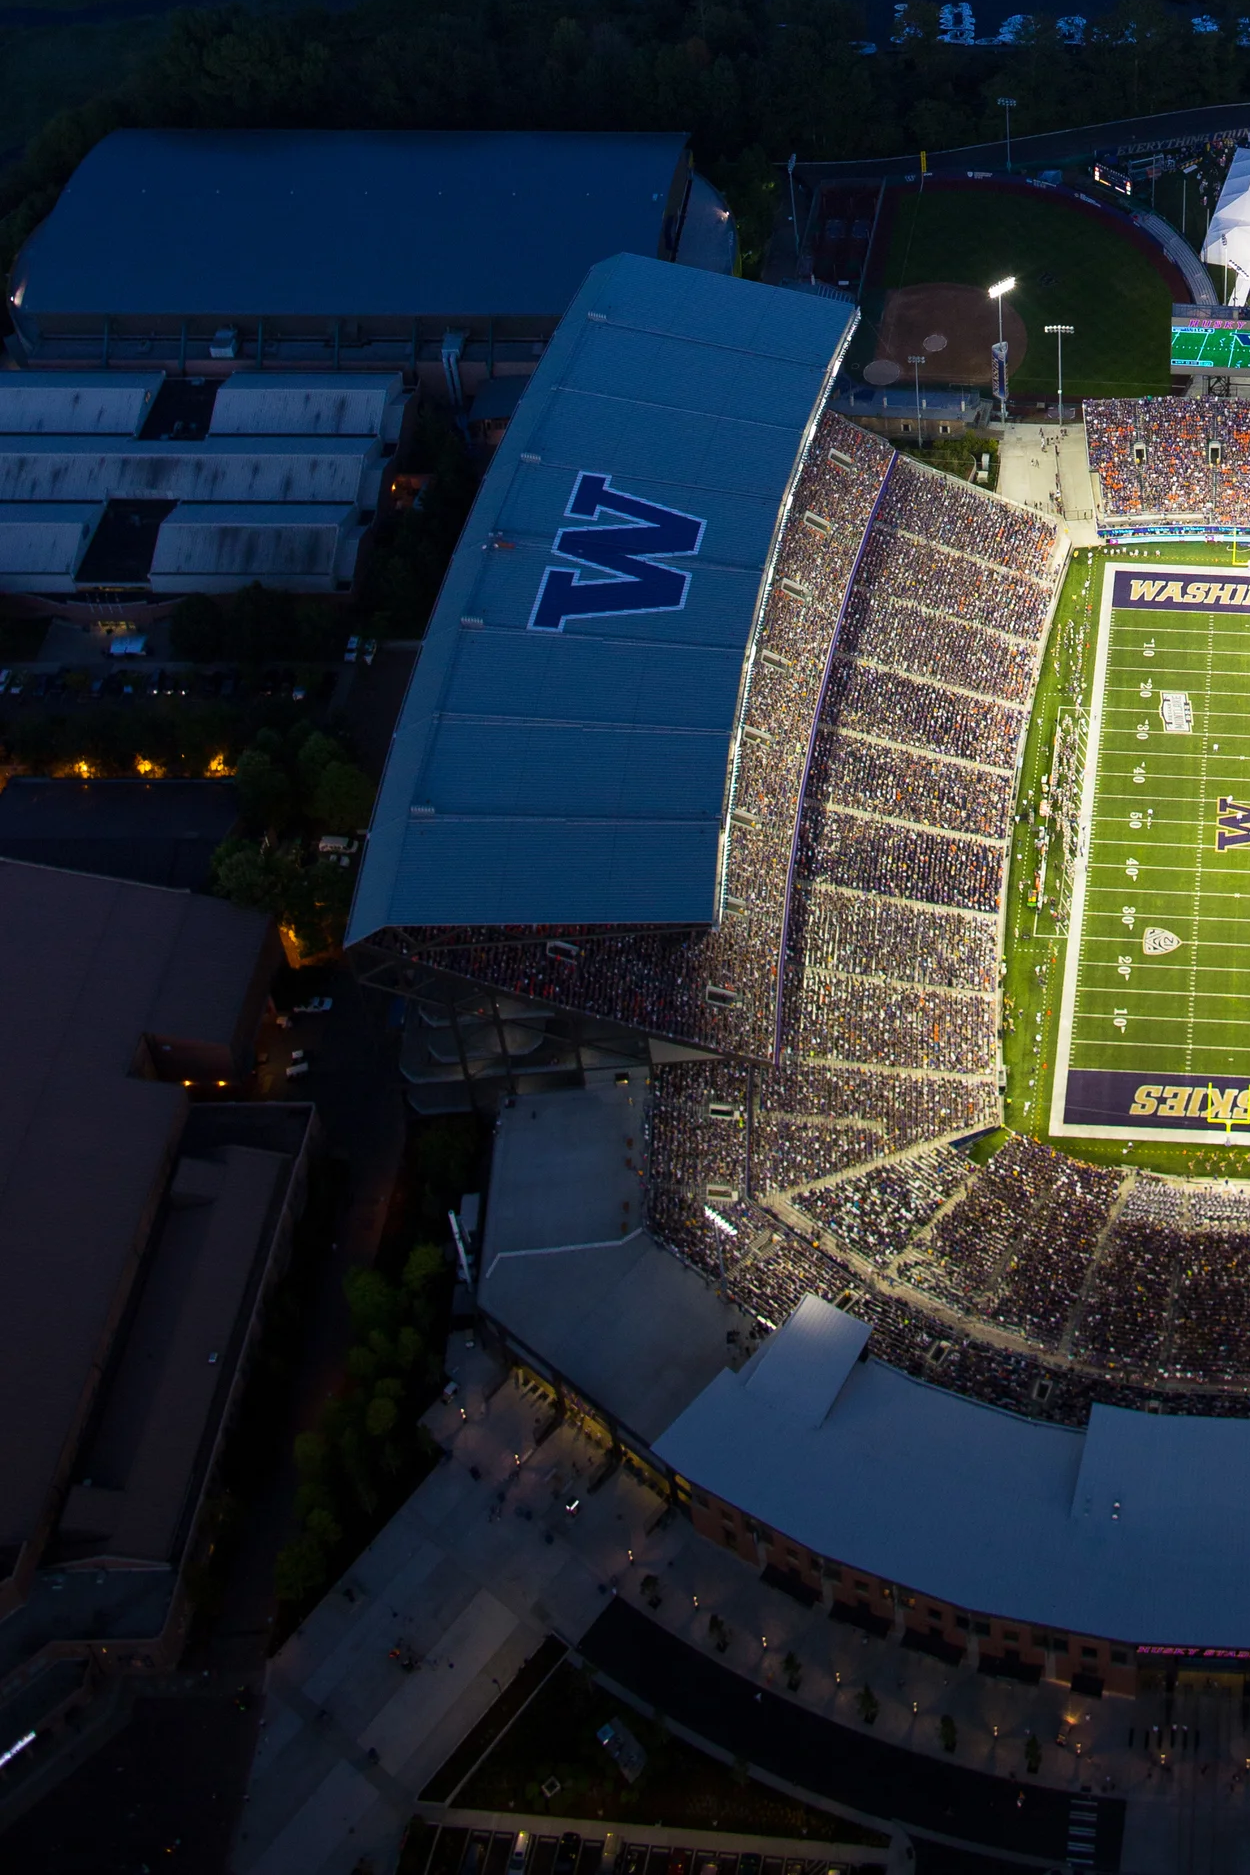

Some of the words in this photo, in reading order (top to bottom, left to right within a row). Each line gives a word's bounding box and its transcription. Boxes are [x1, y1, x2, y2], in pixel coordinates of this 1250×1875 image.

[1117, 134, 1210, 156] EVERYTHING
[1188, 319, 1246, 329] HUSKY
[526, 471, 707, 632] W
[1143, 642, 1155, 657] 10
[1140, 682, 1152, 698] 20
[1136, 724, 1149, 740] 30
[1133, 766, 1146, 784] 40
[1129, 811, 1143, 829] 50
[1125, 857, 1139, 876] 40
[1121, 906, 1136, 925] 30
[1163, 936, 1174, 947] 12
[1117, 955, 1132, 974] 20
[1113, 1008, 1128, 1027] 10
[1136, 1646, 1200, 1656] HUSKY
